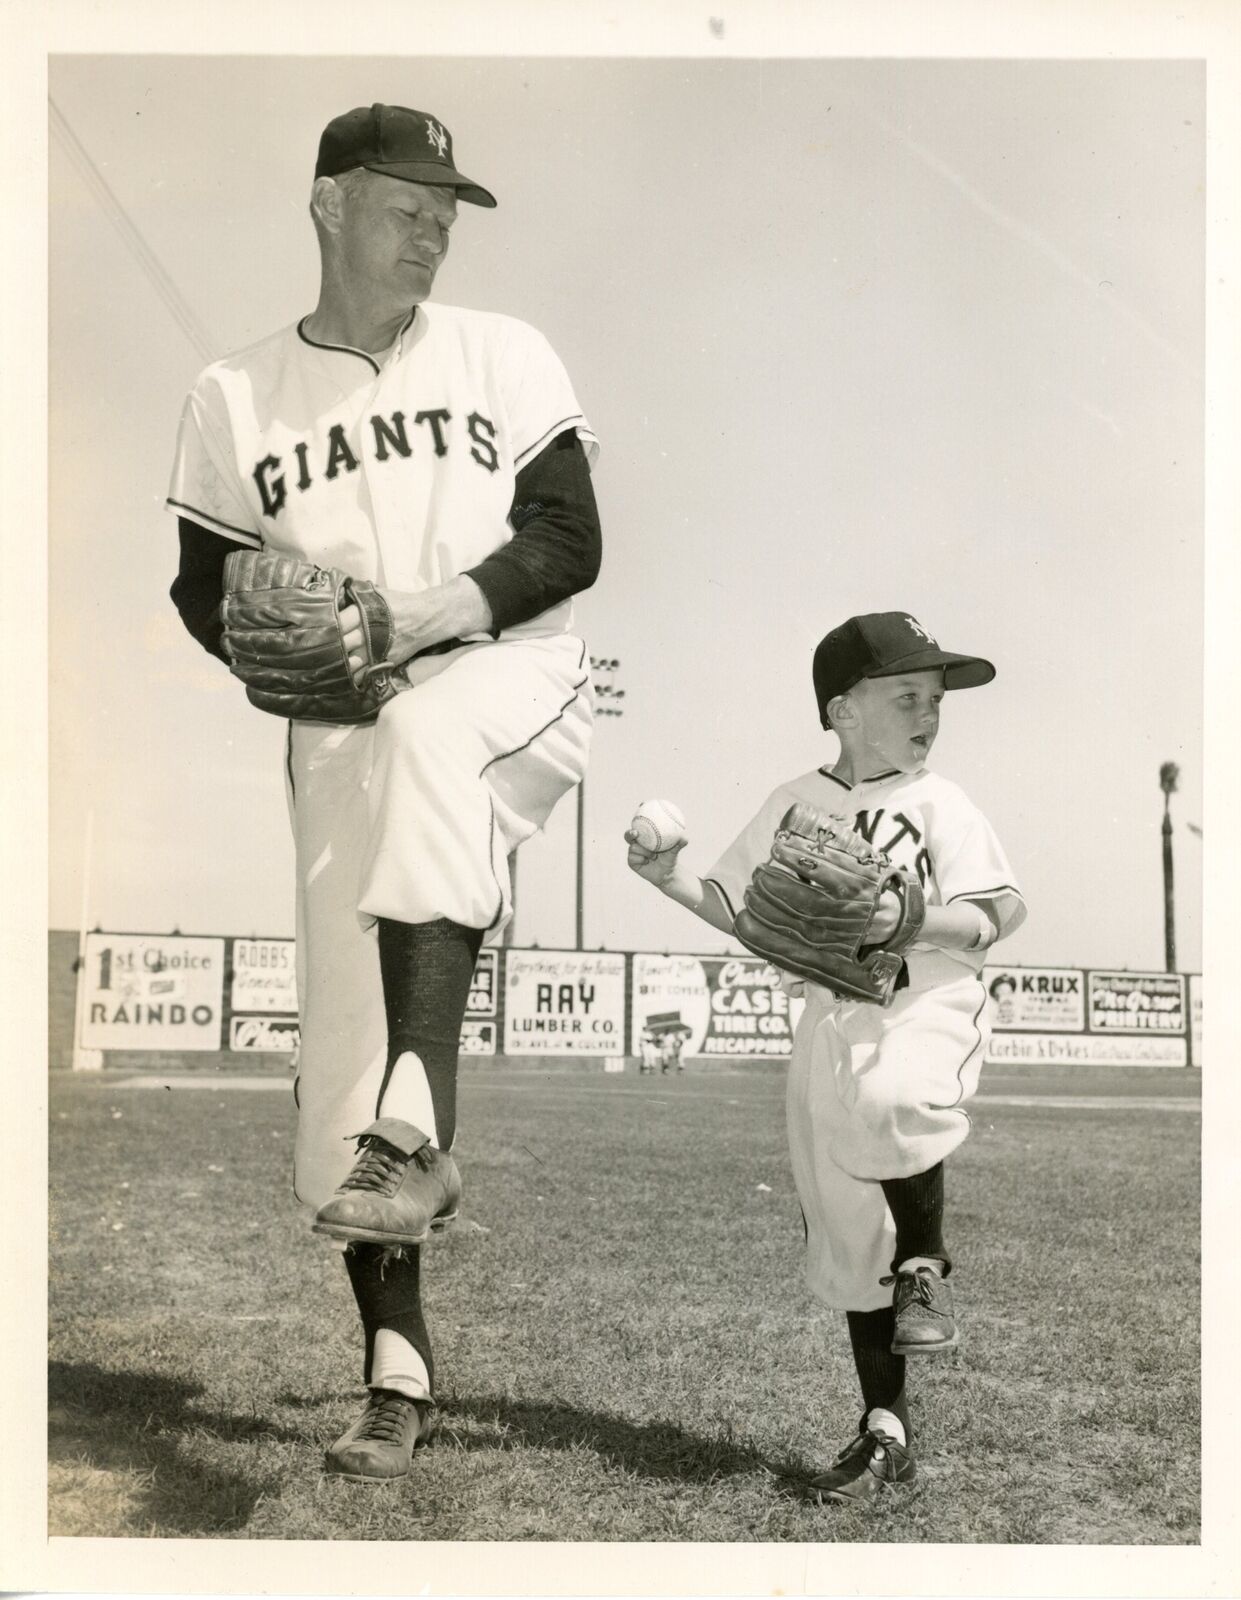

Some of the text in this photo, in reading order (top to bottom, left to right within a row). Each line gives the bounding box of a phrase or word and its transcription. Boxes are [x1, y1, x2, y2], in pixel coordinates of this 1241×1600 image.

[425, 119, 448, 158] NY
[253, 408, 500, 519] GIANTS
[97, 948, 212, 991] 1st Choice
[1021, 975, 1079, 994] KRUX
[537, 984, 595, 1014] RAY
[711, 989, 788, 1014] CASE
[90, 1003, 214, 1026] RAINBO
[712, 1015, 789, 1034] TIRE CO.
[1093, 1010, 1182, 1028] PRINTERY
[513, 1018, 619, 1034] LUMBER CO.
[705, 1037, 793, 1054] RECAPPING
[989, 1039, 1033, 1057] Corbin
[1049, 1040, 1088, 1058] Dykes
